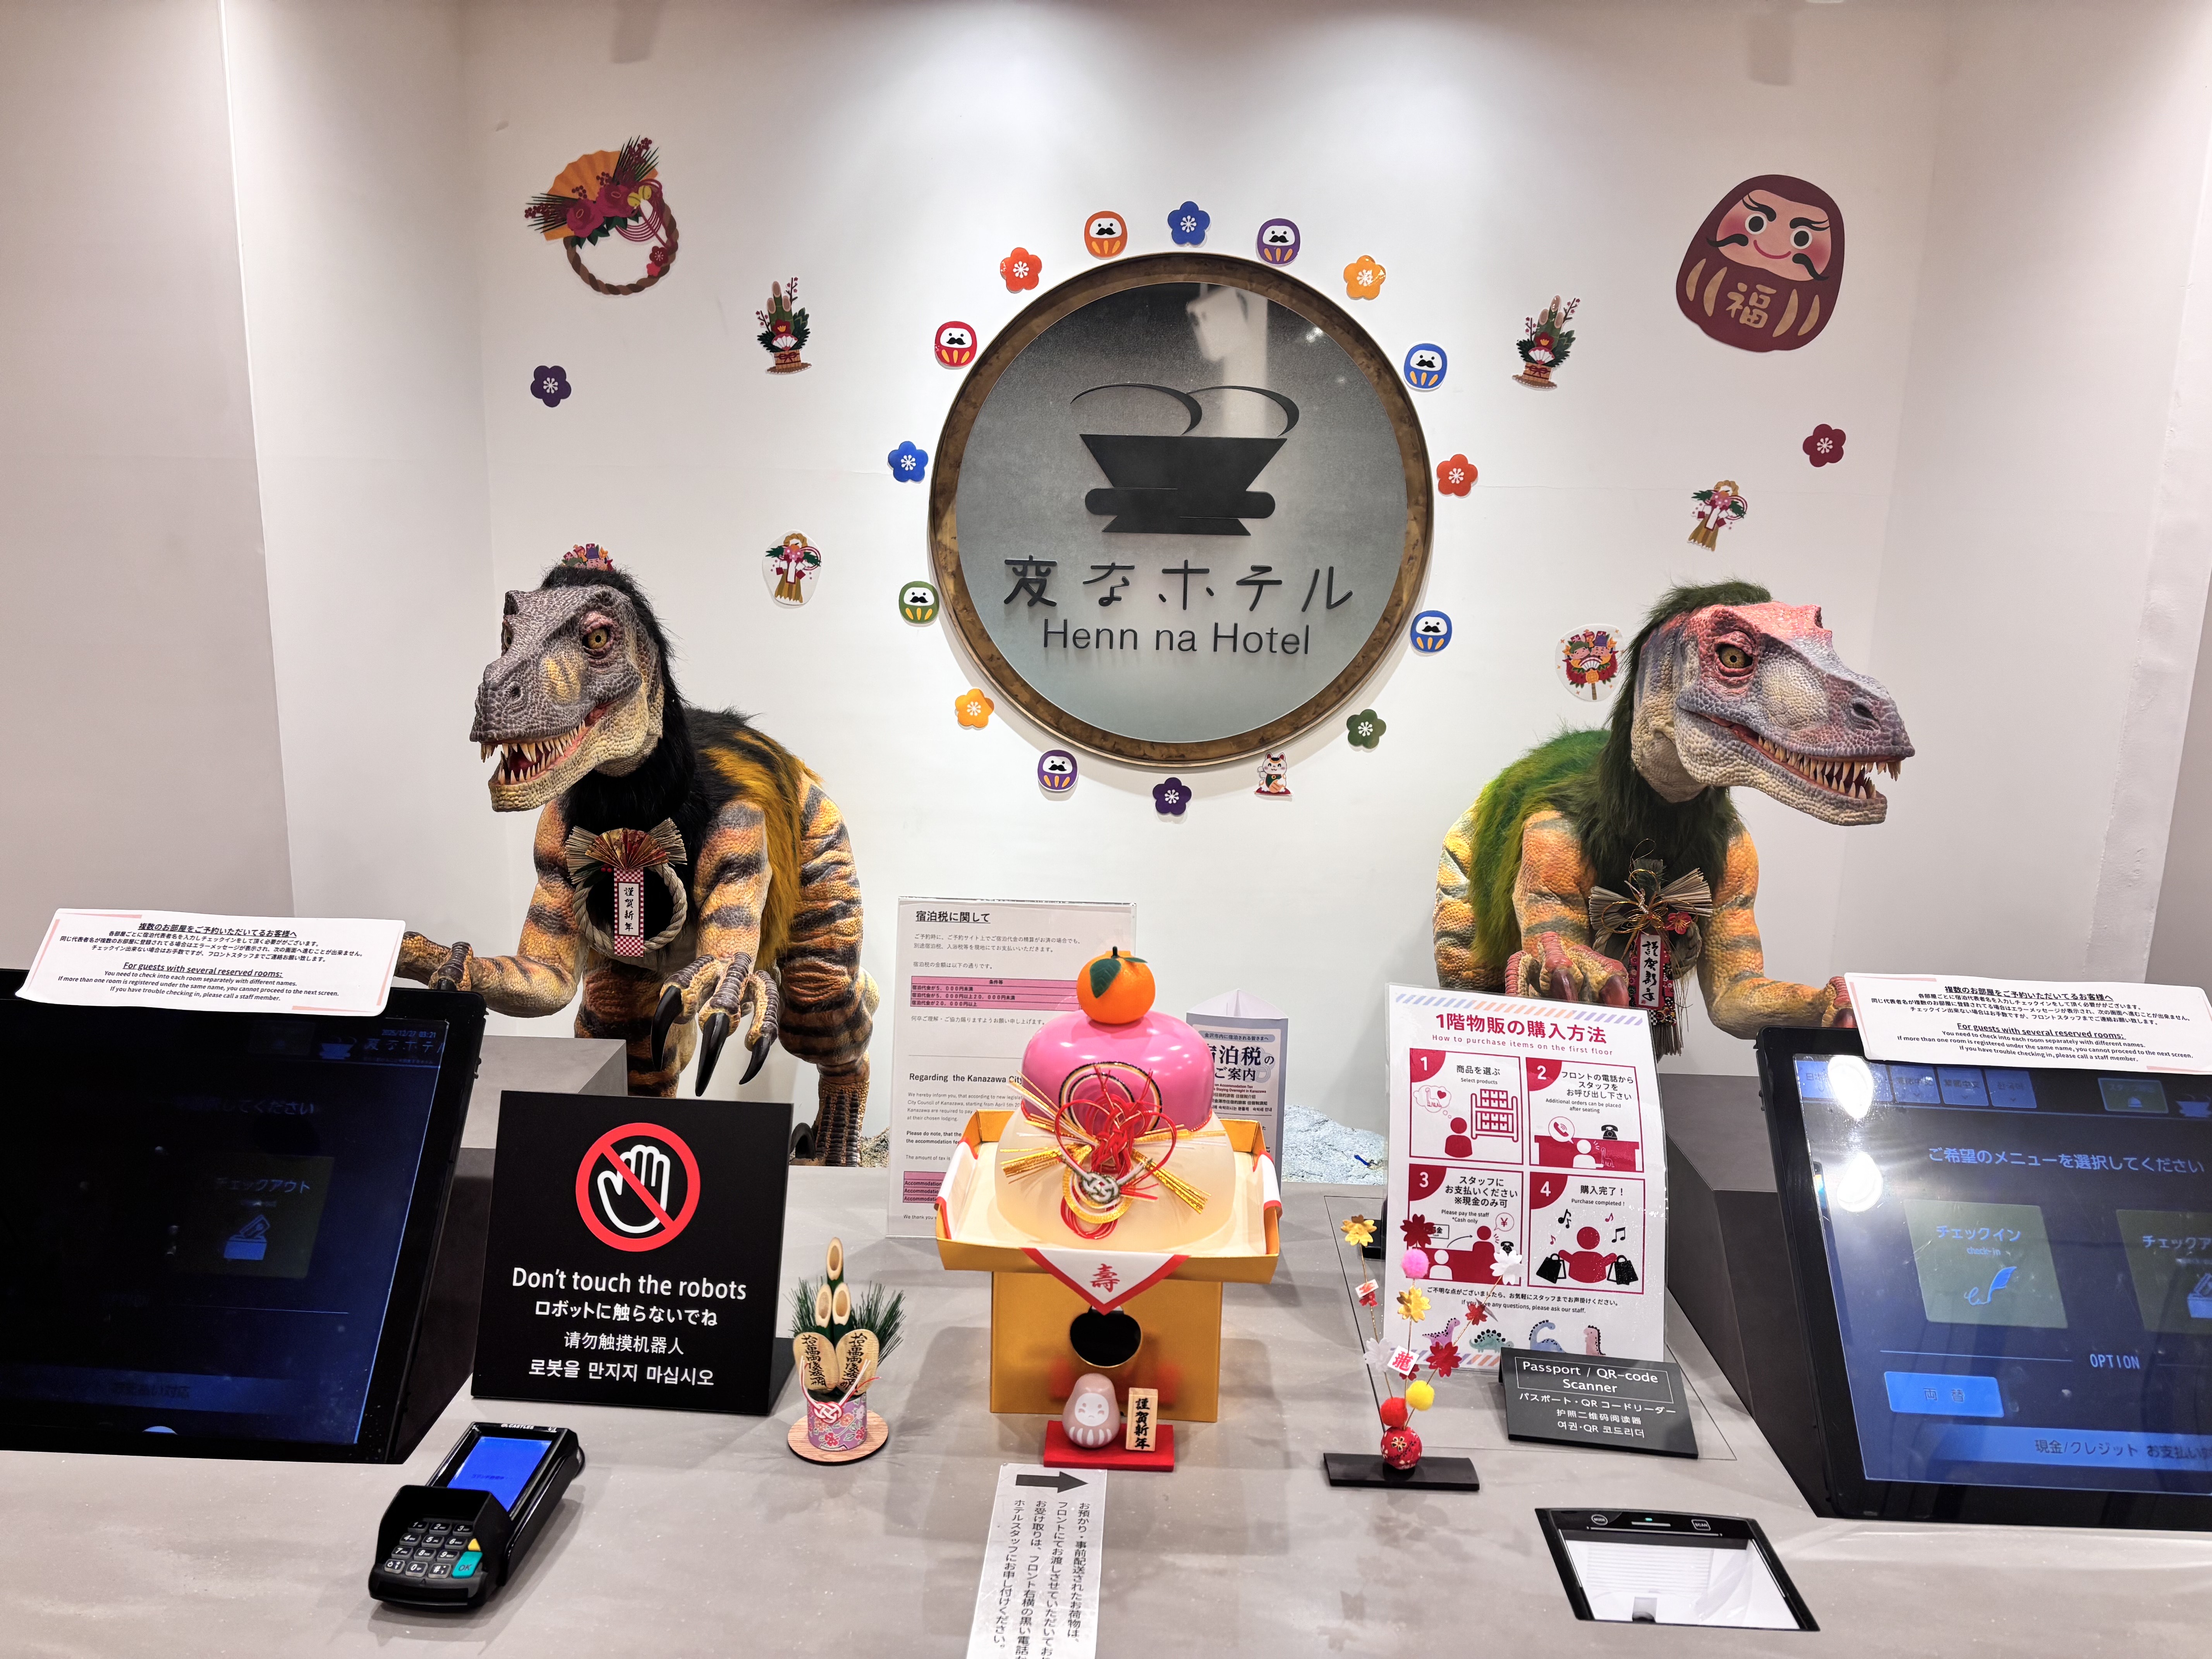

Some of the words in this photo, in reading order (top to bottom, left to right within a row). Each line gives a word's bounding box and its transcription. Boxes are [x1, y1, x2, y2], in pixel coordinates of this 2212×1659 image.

[1726, 282, 1778, 330] 福
[1004, 555, 1353, 612] 変なホテル
[1044, 618, 1139, 650] Henn
[1155, 628, 1197, 652] na
[1213, 621, 1310, 655] Hotel
[915, 910, 991, 923] 宿泊税に関して
[138, 922, 297, 938] 複数のお部屋をご予約いただいてるお客様へ
[122, 962, 138, 970] For
[137, 963, 166, 972] guests
[216, 969, 254, 977] reserved
[166, 989, 194, 997] checking
[1435, 1012, 1607, 1044] 1階物販の購入方法
[1466, 1038, 1506, 1046] purchase
[1510, 1040, 1534, 1048] items
[1591, 1047, 1613, 1055] floor
[1420, 1056, 1427, 1071] 1
[1456, 1065, 1500, 1075] 商品を選ぶ
[909, 1073, 948, 1082] Regarding
[952, 1073, 965, 1082] the
[967, 1074, 1006, 1083] Kanazawa
[1214, 1066, 1256, 1082] ご案内
[1537, 1065, 1547, 1080] 2
[1561, 1071, 1634, 1084] フロントの電話から
[1578, 1081, 1618, 1091] スタッフを
[1566, 1089, 1632, 1100] お呼び出し下さい
[1929, 1147, 2204, 1174] ご希望のメニューを選択してください
[1419, 1171, 1429, 1188] 3
[1460, 1176, 1504, 1187] スタッフに
[1445, 1185, 1518, 1198] お支払いください
[1540, 1181, 1551, 1197] 4
[1454, 1197, 1508, 1208] ※現金のみ可
[1936, 1225, 2021, 1242] チェックイン
[512, 1267, 567, 1289] Don't
[572, 1272, 631, 1293] touch
[638, 1274, 672, 1295] the
[679, 1277, 746, 1300] robots
[535, 1300, 718, 1326] ロボットに触らないでね
[564, 1331, 684, 1355] 请勿触摸机器人
[2090, 1354, 2140, 1370] OPTION
[529, 1359, 580, 1378] 로봇을
[589, 1362, 638, 1382] 만지지
[646, 1365, 714, 1386] 마십시오
[1523, 1360, 1581, 1377] Passport
[1596, 1368, 1659, 1383] QR-code
[1563, 1378, 1618, 1393] Scanner
[1133, 1397, 1150, 1449] 謹賀新年
[1556, 1408, 1642, 1425] 护照二维码阅读器
[1602, 1425, 1645, 1439] 코드리더
[2034, 1439, 2138, 1458] 現金/クレジット
[994, 1499, 1025, 1649] ホテルスタッフにお申し付けください。
